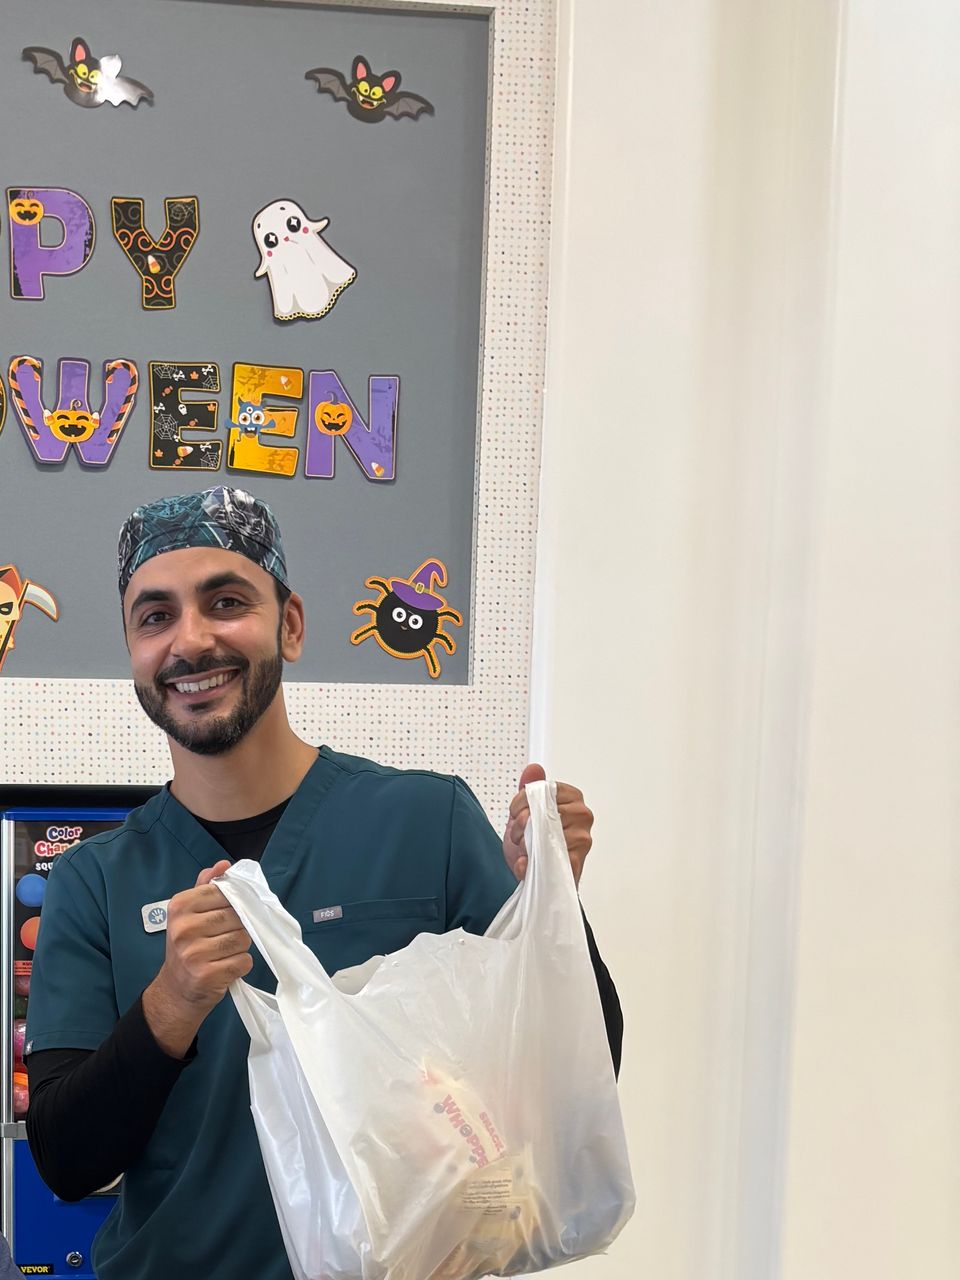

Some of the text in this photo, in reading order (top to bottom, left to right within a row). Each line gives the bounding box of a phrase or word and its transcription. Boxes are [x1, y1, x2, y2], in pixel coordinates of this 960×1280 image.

[47, 827, 82, 840] Color
[35, 842, 69, 856] Chan
[35, 862, 54, 871] SQU
[442, 1094, 489, 1169] WHOPPE
